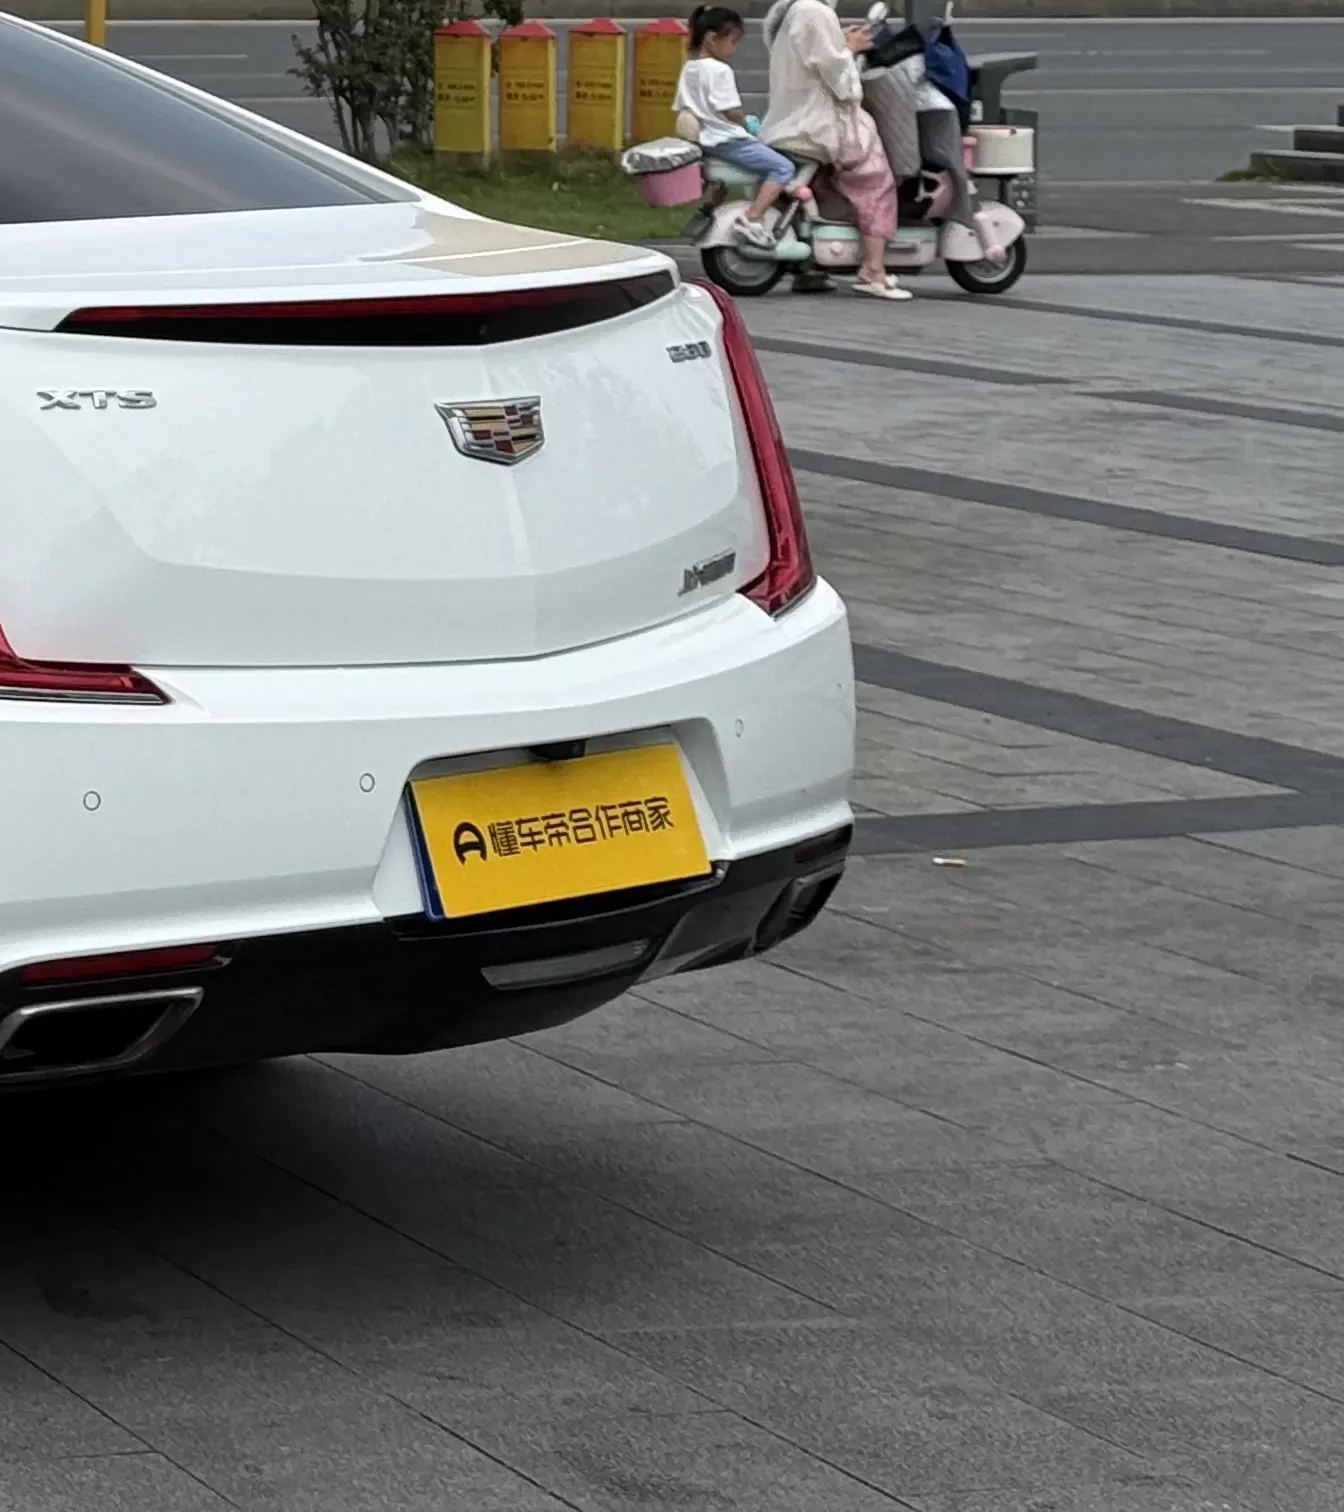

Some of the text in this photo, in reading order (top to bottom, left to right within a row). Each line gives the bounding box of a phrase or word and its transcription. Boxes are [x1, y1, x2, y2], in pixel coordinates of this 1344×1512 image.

[36, 390, 157, 410] XTS
[487, 796, 675, 858] 懂车帝合作商家
